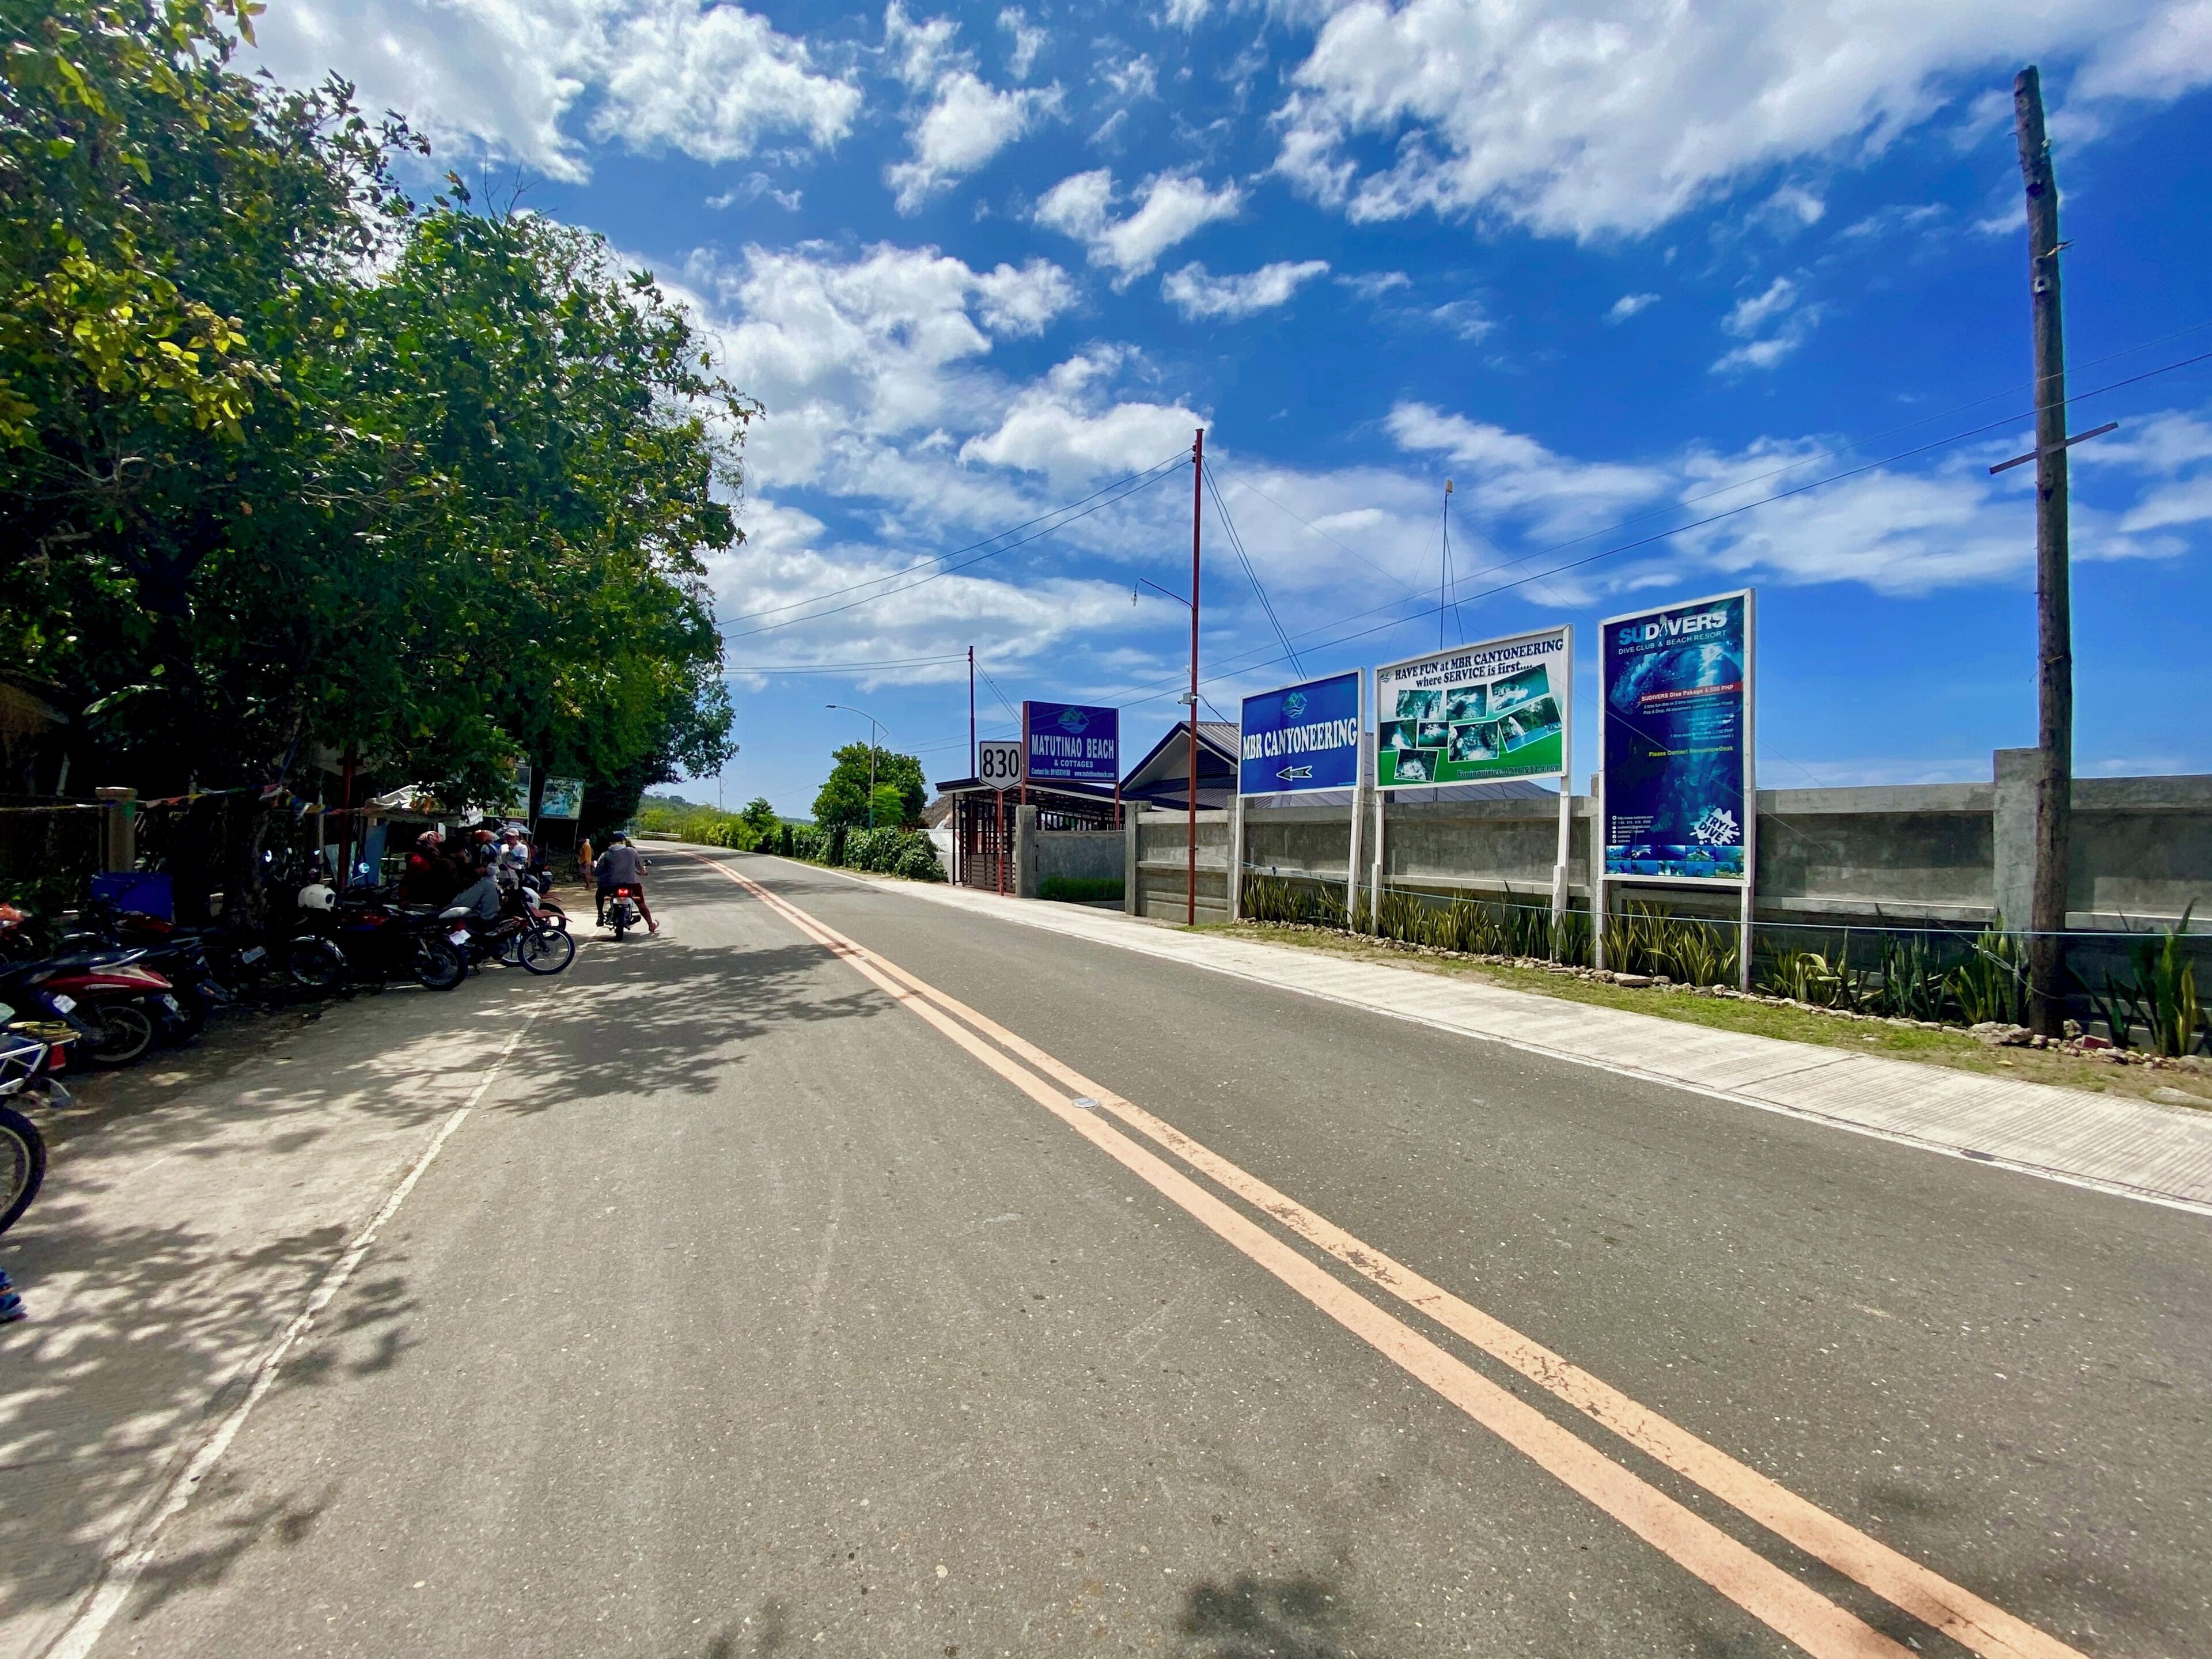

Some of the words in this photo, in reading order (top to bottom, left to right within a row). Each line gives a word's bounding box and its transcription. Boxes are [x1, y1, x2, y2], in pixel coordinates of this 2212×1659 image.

[1618, 646, 1635, 654] DIVE
[1636, 643, 1655, 651] CLUB
[1666, 636, 1692, 646] BEACH
[1694, 630, 1728, 641] RESORT
[1395, 665, 1418, 680] HAVE
[1419, 662, 1438, 676] FUN
[1440, 662, 1449, 672] at
[1451, 656, 1471, 670] MBR
[1474, 639, 1563, 665] CANYONEERING
[1416, 676, 1442, 688] where
[1444, 665, 1485, 683] SERVICE
[1487, 665, 1495, 676] is
[1641, 693, 1668, 701] SUDIVERS
[1032, 734, 1082, 757] MATUTINAO
[1087, 738, 1115, 759] BEACH
[1243, 733, 1263, 760] MBR
[1264, 718, 1358, 757] CANYONEERING
[983, 749, 1019, 778] 830
[1060, 760, 1094, 768] COTTAGES
[1457, 770, 1468, 778] For
[1470, 767, 1502, 778] inquiries:
[1699, 821, 1724, 841] DIVE
[1706, 813, 1730, 832] TRY!
